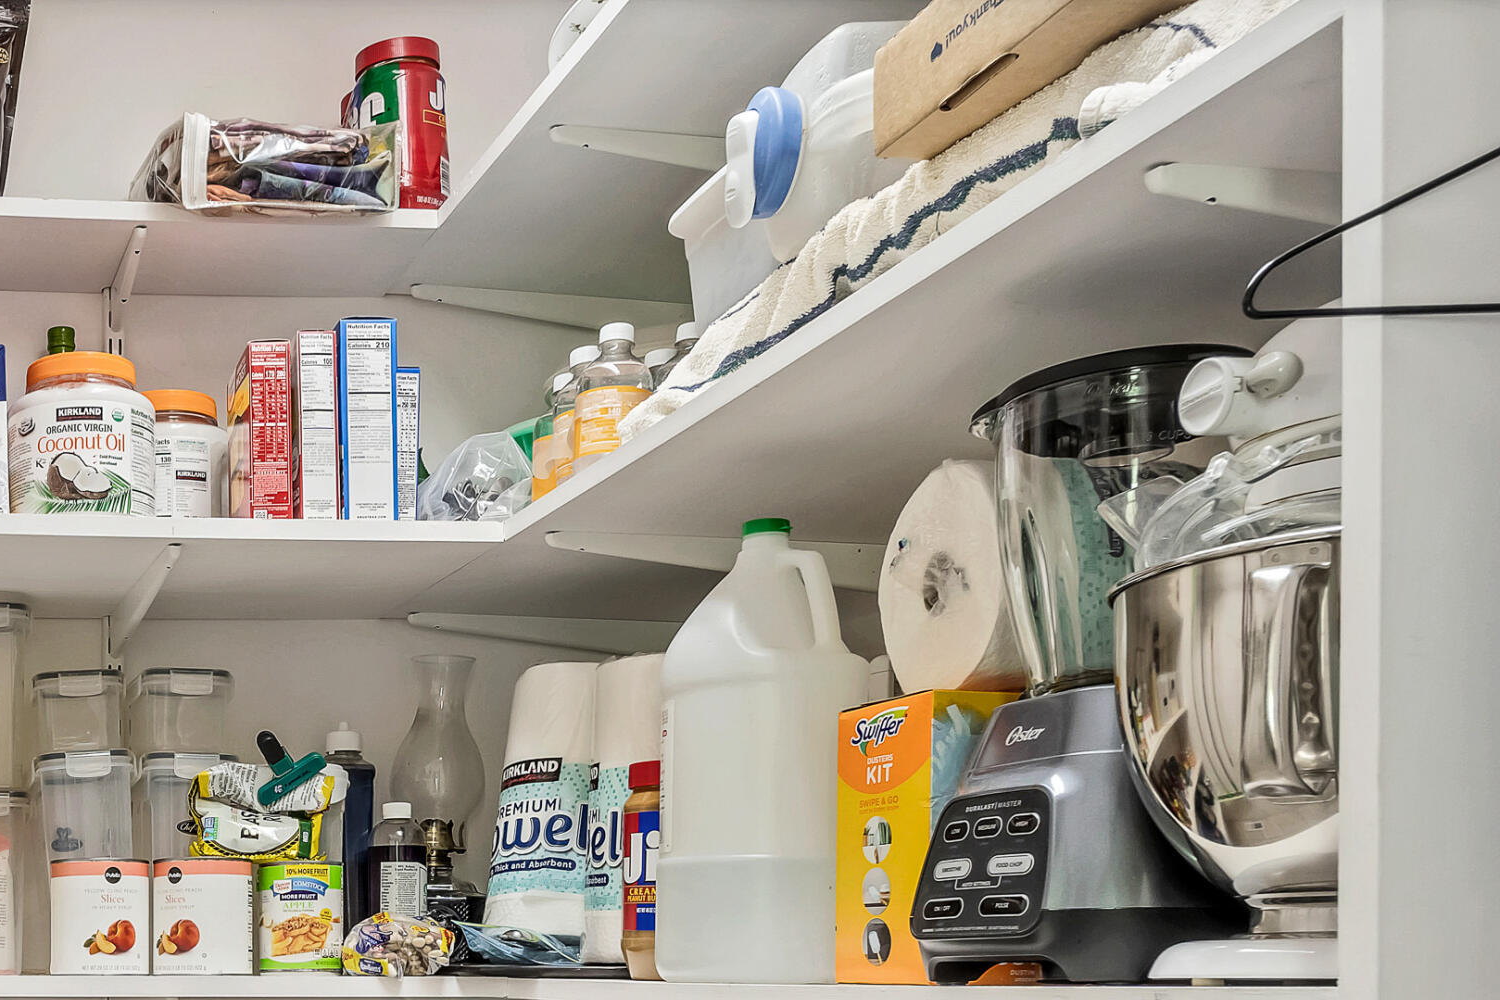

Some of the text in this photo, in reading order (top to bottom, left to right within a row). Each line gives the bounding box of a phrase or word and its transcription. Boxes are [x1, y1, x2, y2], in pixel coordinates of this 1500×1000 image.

[58, 408, 102, 417] KIRKLAND
[46, 423, 113, 435] ORGANIC VIRGIN
[37, 433, 125, 454] Coconut Oil
[177, 470, 206, 478] KIRKLAND
[851, 714, 905, 747] Swiffer
[1005, 725, 1045, 747] Oster
[866, 754, 893, 765] DUSTERS
[502, 760, 560, 780] KIRKLAND
[866, 764, 893, 784] KIT
[859, 797, 880, 809] SWIPE
[511, 859, 572, 869] and Absorbent
[292, 881, 325, 892] COMSTOCK
[101, 894, 125, 904] Slices
[164, 894, 186, 904] Slices
[284, 901, 314, 909] APPLE
